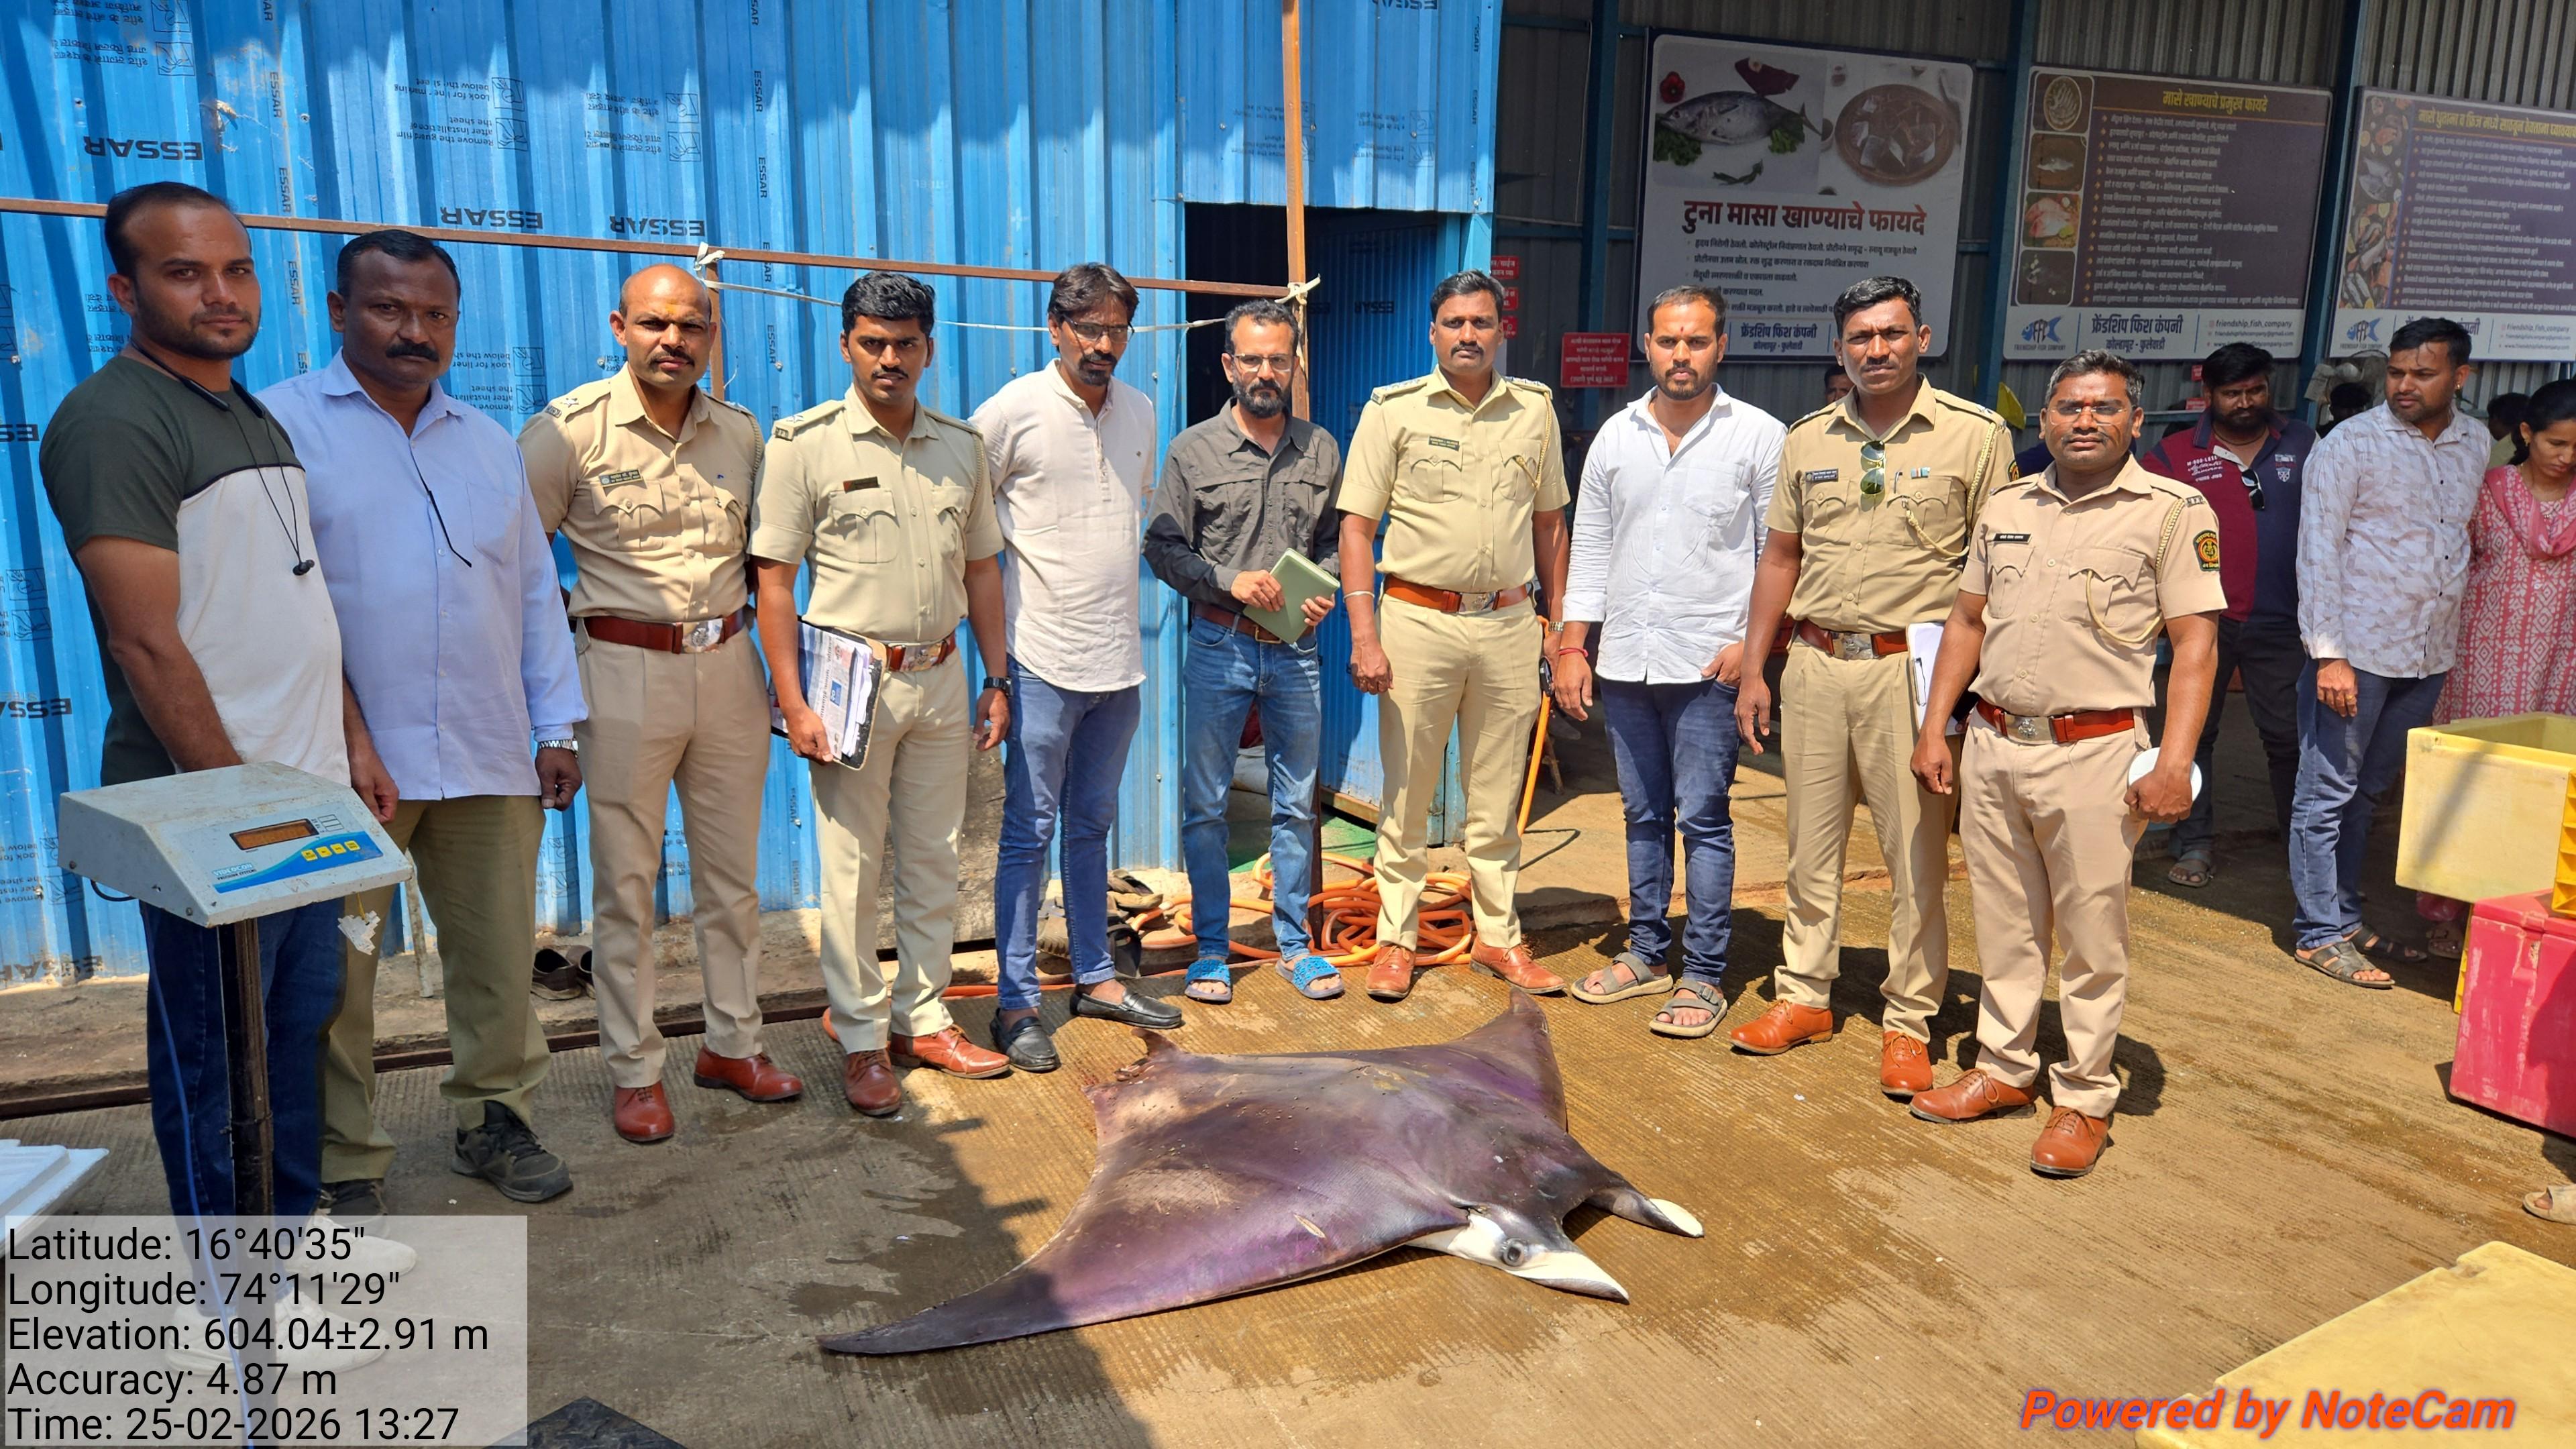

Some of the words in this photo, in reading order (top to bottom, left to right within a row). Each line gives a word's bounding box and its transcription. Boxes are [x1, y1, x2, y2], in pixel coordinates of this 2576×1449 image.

[270, 72, 282, 119] ESSAR
[453, 91, 467, 100] for
[461, 83, 489, 92] below
[754, 70, 763, 113] ESSAR
[469, 93, 490, 101] Look
[2163, 88, 2183, 106] मासे
[2184, 91, 2219, 108] खाण्याचे
[2219, 95, 2244, 115] प्रमुख
[2245, 94, 2268, 113] फायदे
[449, 117, 476, 125] sheet
[478, 119, 492, 127] the
[439, 136, 455, 144] the
[472, 128, 493, 136] after
[84, 136, 204, 161] ESSAR
[458, 136, 494, 146] Remove
[758, 157, 767, 199] ESSAR
[279, 167, 291, 213] ESSAR
[440, 207, 544, 230] ESSAR
[610, 215, 706, 237] ESSAR
[1682, 201, 1723, 234] टुना
[1727, 203, 1778, 227] मासा
[1782, 201, 1865, 231] खाण्याचे
[1869, 205, 1927, 235] फायदे
[763, 242, 771, 282] EAR
[288, 261, 301, 306] ESSAR
[1308, 302, 1330, 315] ESS
[1354, 301, 1395, 314] ESSAR
[1741, 322, 1771, 337] फ्रेंडशिप
[1773, 323, 1792, 338] फिश
[1793, 323, 1817, 338] कंपनी
[2092, 313, 2129, 334] फ्रेंडशिप
[2130, 314, 2152, 334] फिश
[2154, 314, 2184, 334] कंपनी
[2457, 317, 2481, 335] ंपनी
[767, 325, 776, 365] ESSAR
[2106, 337, 2133, 353] कोल्हापूर
[2140, 337, 2165, 353] फुलेवाडी
[475, 361, 488, 370] for
[483, 353, 511, 361] below
[0, 698, 72, 719] ESS
[213, 862, 254, 877] VIDEOCON
